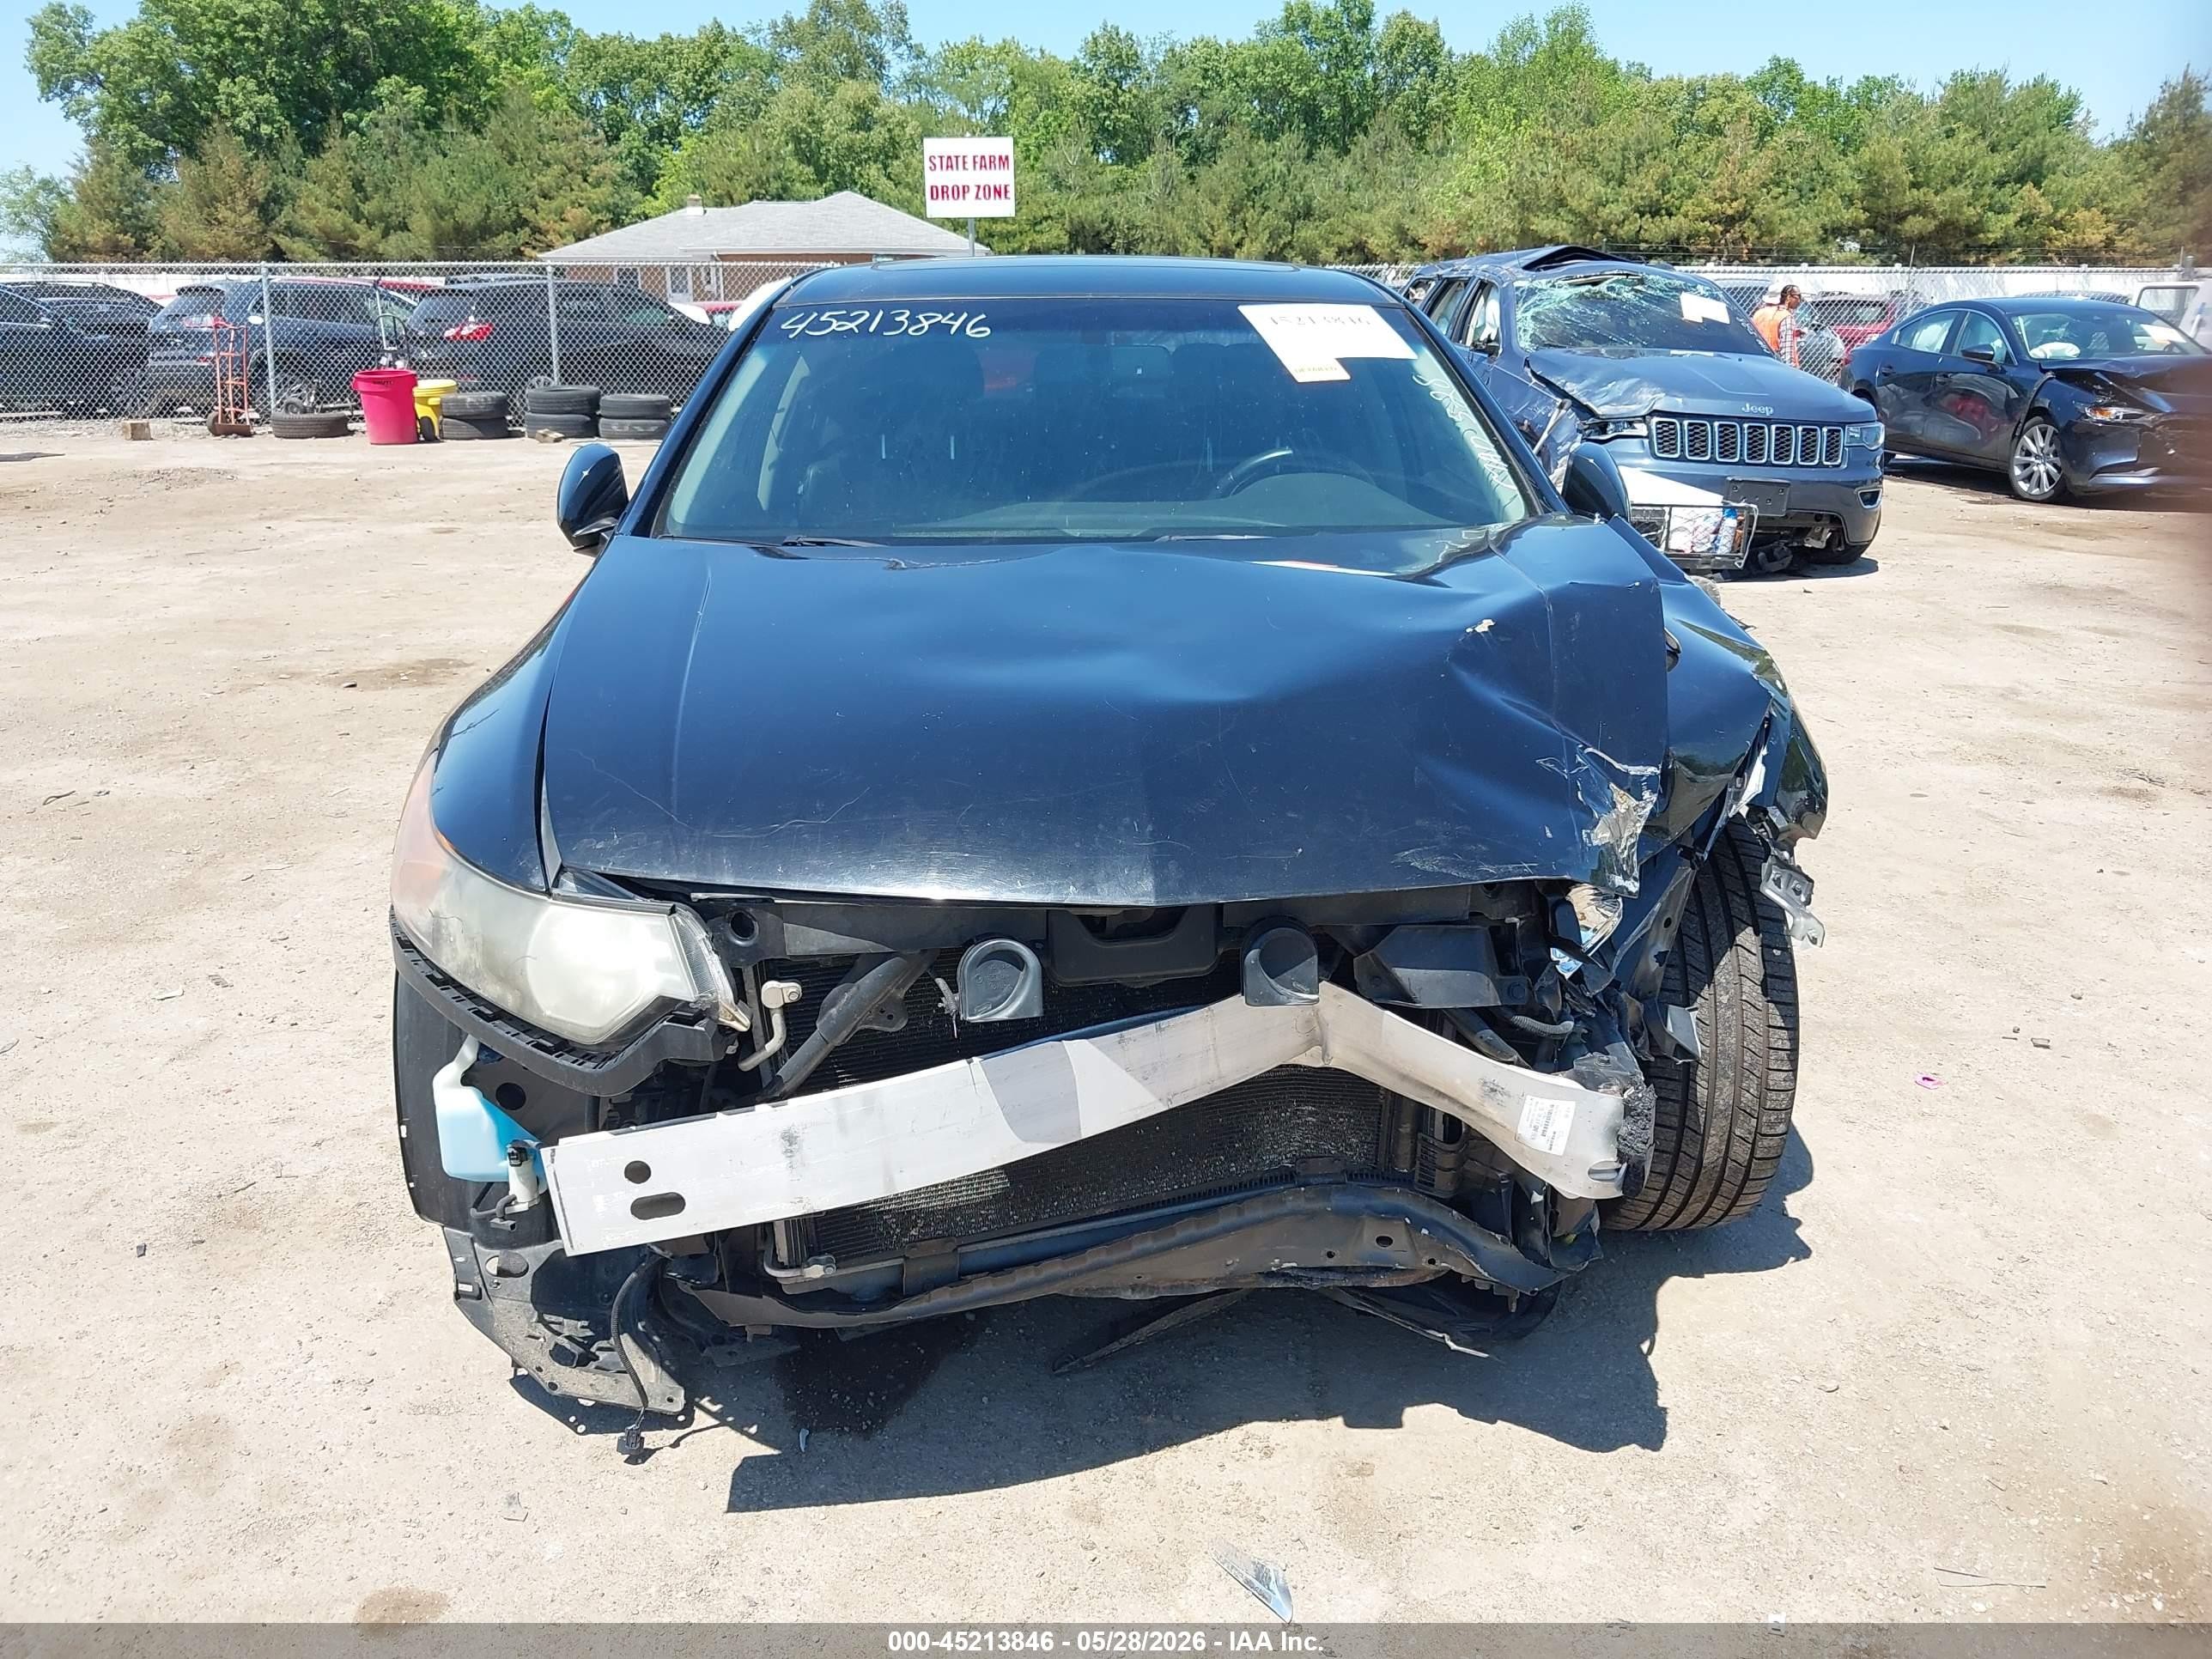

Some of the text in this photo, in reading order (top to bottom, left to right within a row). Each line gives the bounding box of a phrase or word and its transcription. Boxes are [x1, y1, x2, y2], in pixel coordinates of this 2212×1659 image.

[928, 155, 1010, 172] STATE FARM
[930, 184, 1011, 201] DROP ZONE
[780, 309, 992, 338] 45213846
[1741, 403, 1774, 416] Jeep
